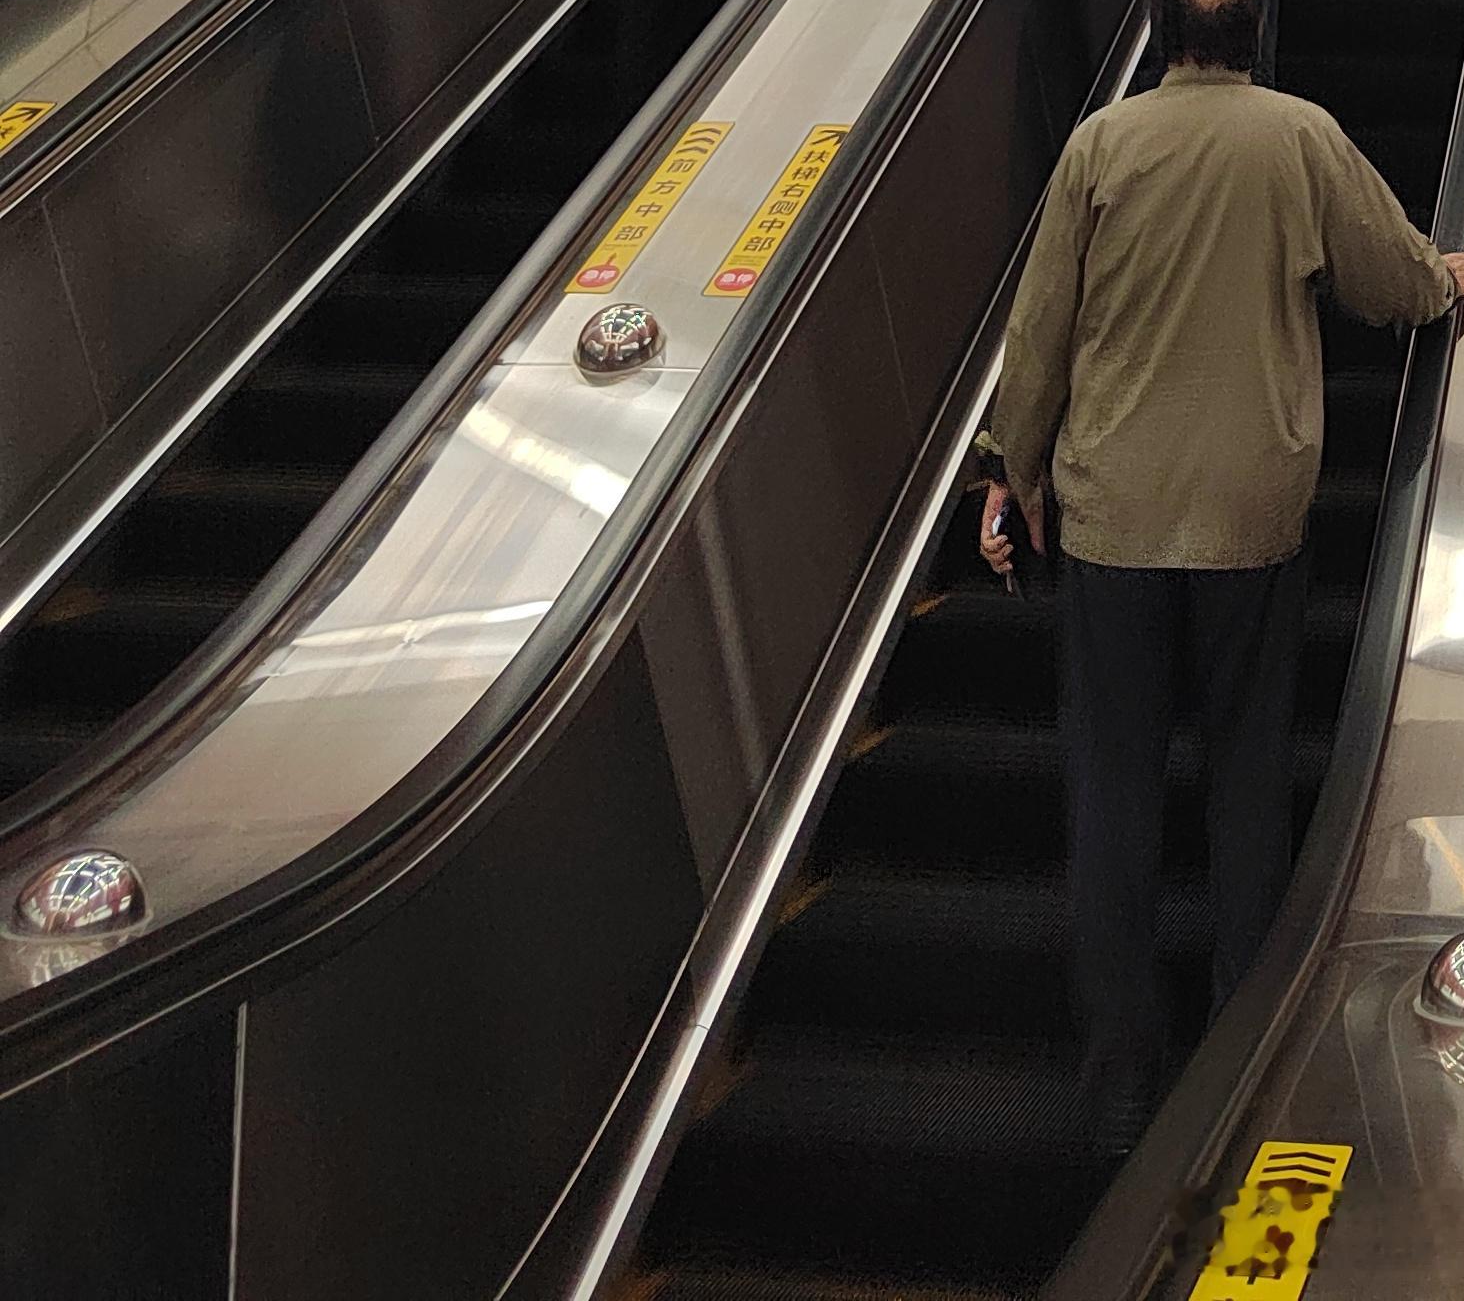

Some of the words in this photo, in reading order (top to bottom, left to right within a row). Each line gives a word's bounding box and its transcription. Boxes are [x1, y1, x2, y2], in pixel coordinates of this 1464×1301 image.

[613, 158, 699, 242] 前方中部
[743, 150, 830, 253] 扶梯右侧中部
